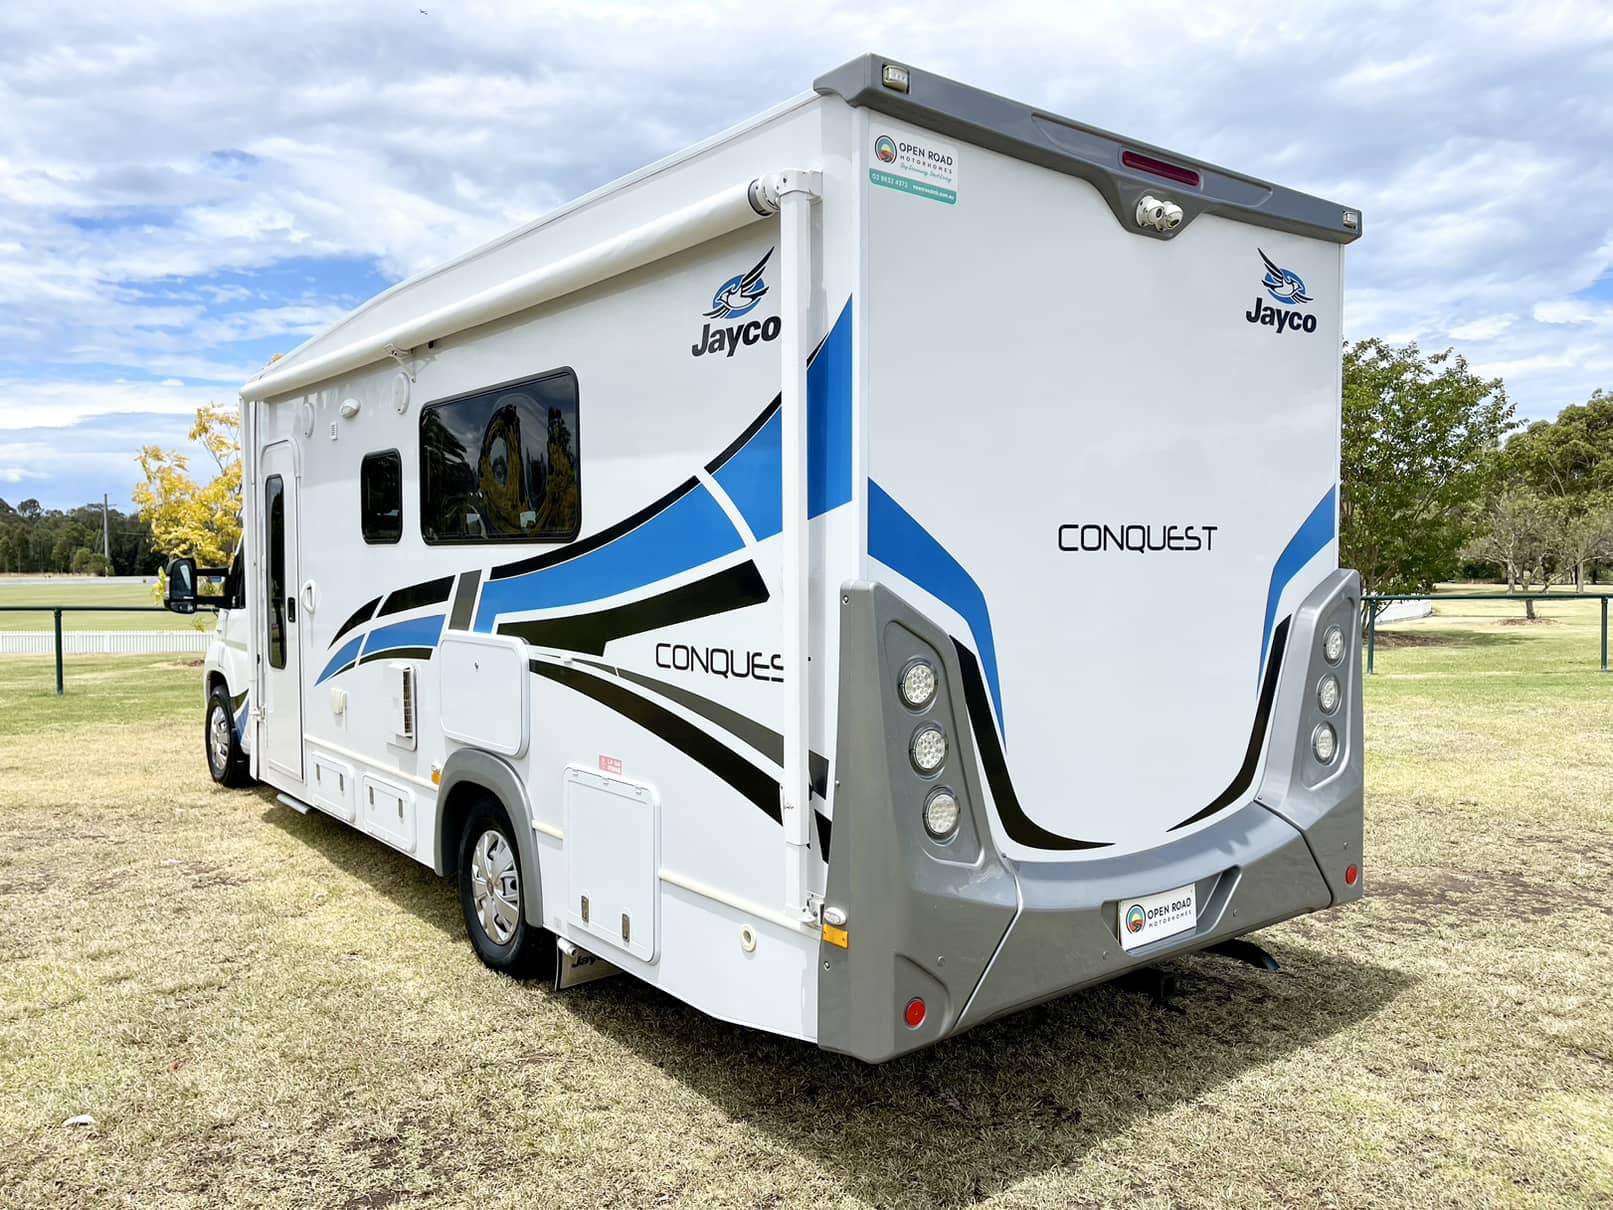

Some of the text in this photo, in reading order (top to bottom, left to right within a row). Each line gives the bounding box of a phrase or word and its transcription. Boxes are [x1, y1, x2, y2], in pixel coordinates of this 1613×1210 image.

[899, 142, 953, 166] OPEN ROAD
[900, 155, 952, 174] MOTORHOMES
[1246, 297, 1317, 334] Jayco
[692, 316, 782, 357] Jayco
[1058, 524, 1218, 554] CONQUEST
[1147, 897, 1192, 920] OPEN ROAD
[1149, 910, 1192, 928] MOTORHOMES
